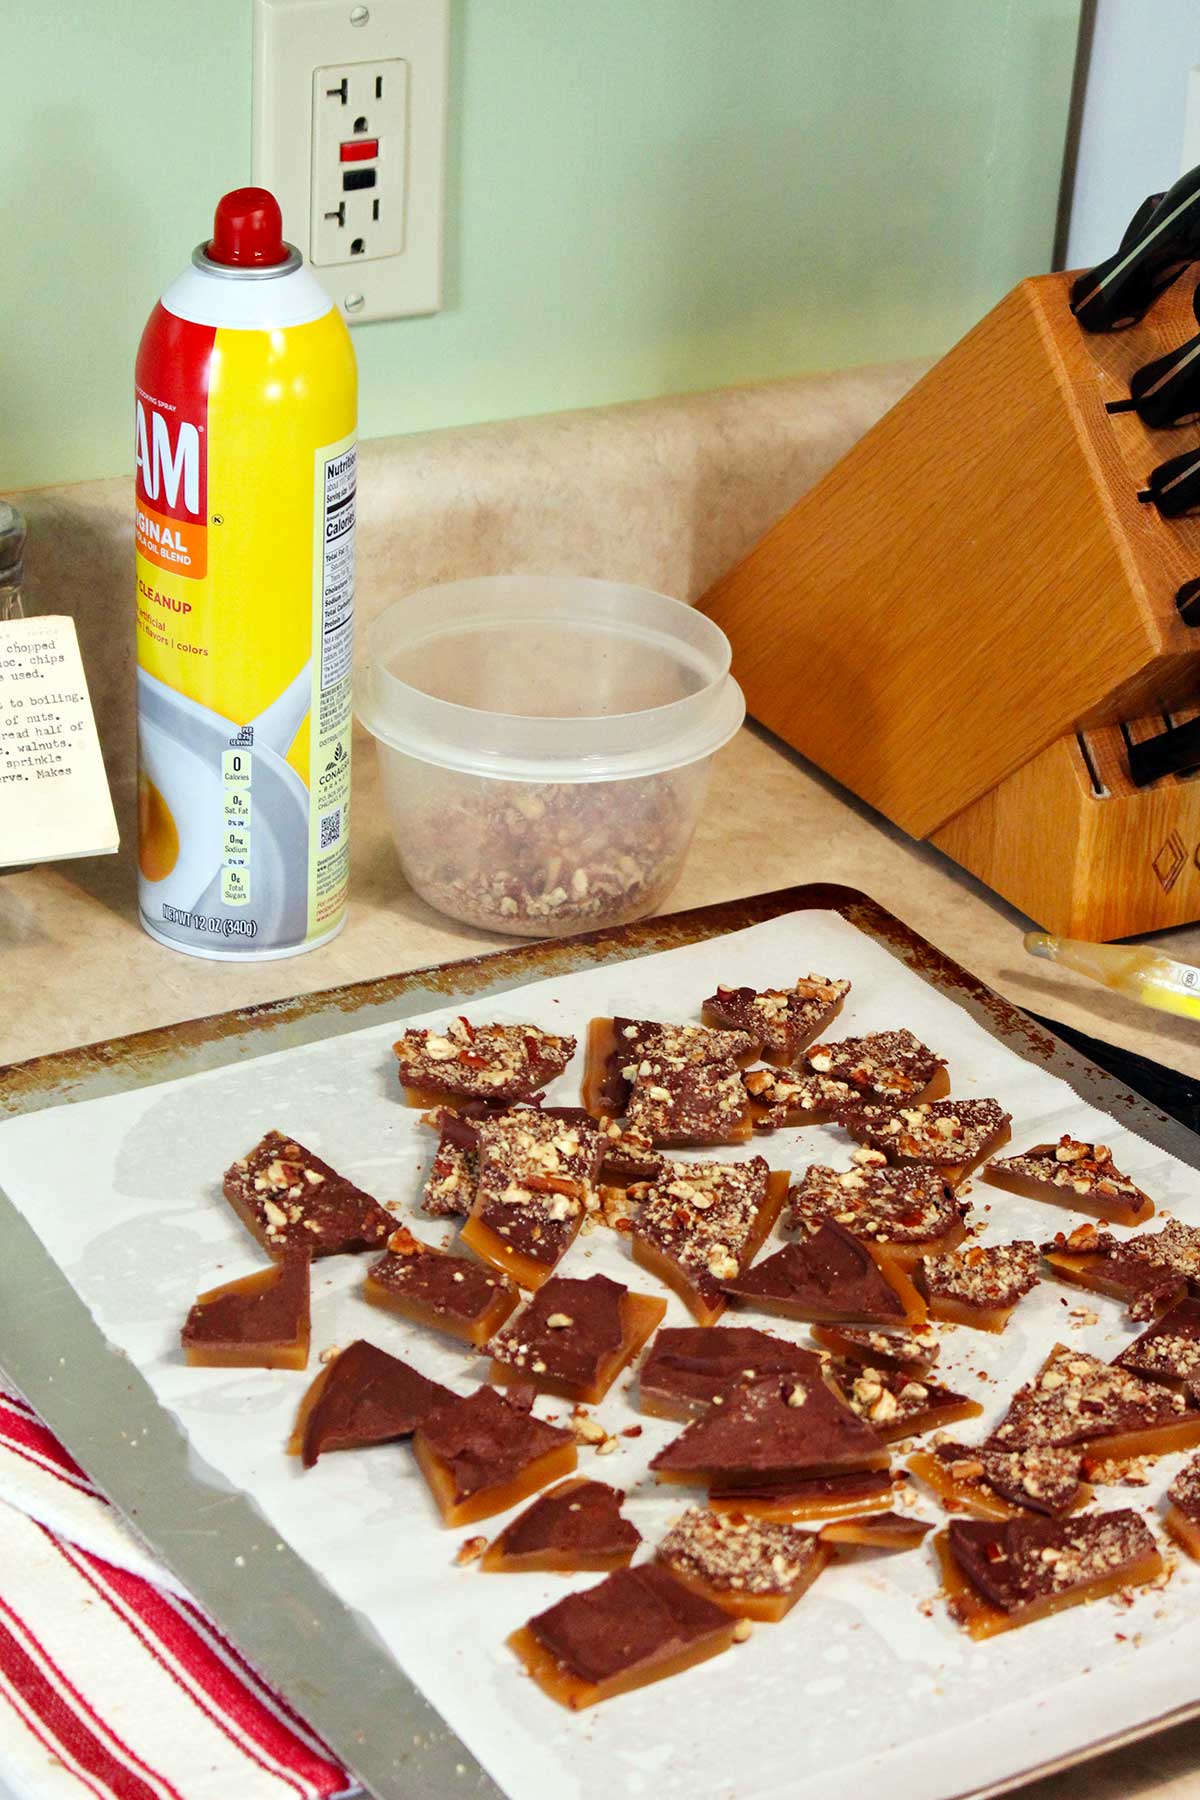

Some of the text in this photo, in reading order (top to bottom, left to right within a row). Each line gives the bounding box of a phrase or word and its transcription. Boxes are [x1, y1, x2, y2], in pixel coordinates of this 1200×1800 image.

[158, 400, 176, 412] SPRAY
[147, 541, 159, 554] OIL
[160, 548, 192, 566] BLEND
[138, 580, 192, 615] CLEANUP
[6, 640, 56, 654] chopped
[176, 642, 208, 656] colors
[30, 654, 65, 665] chips
[11, 669, 44, 681] used.
[10, 698, 23, 708] to
[30, 693, 84, 706] boiling.
[5, 713, 60, 726] of nuts.
[35, 724, 62, 736] half
[70, 721, 83, 732] of
[17, 739, 72, 752] walnuts.
[6, 754, 62, 768] sprinkle
[233, 756, 241, 771] 0
[36, 768, 72, 779] Makes
[225, 891, 246, 900] Sugars
[162, 903, 257, 938] NET WT 12 OZ (340g)
